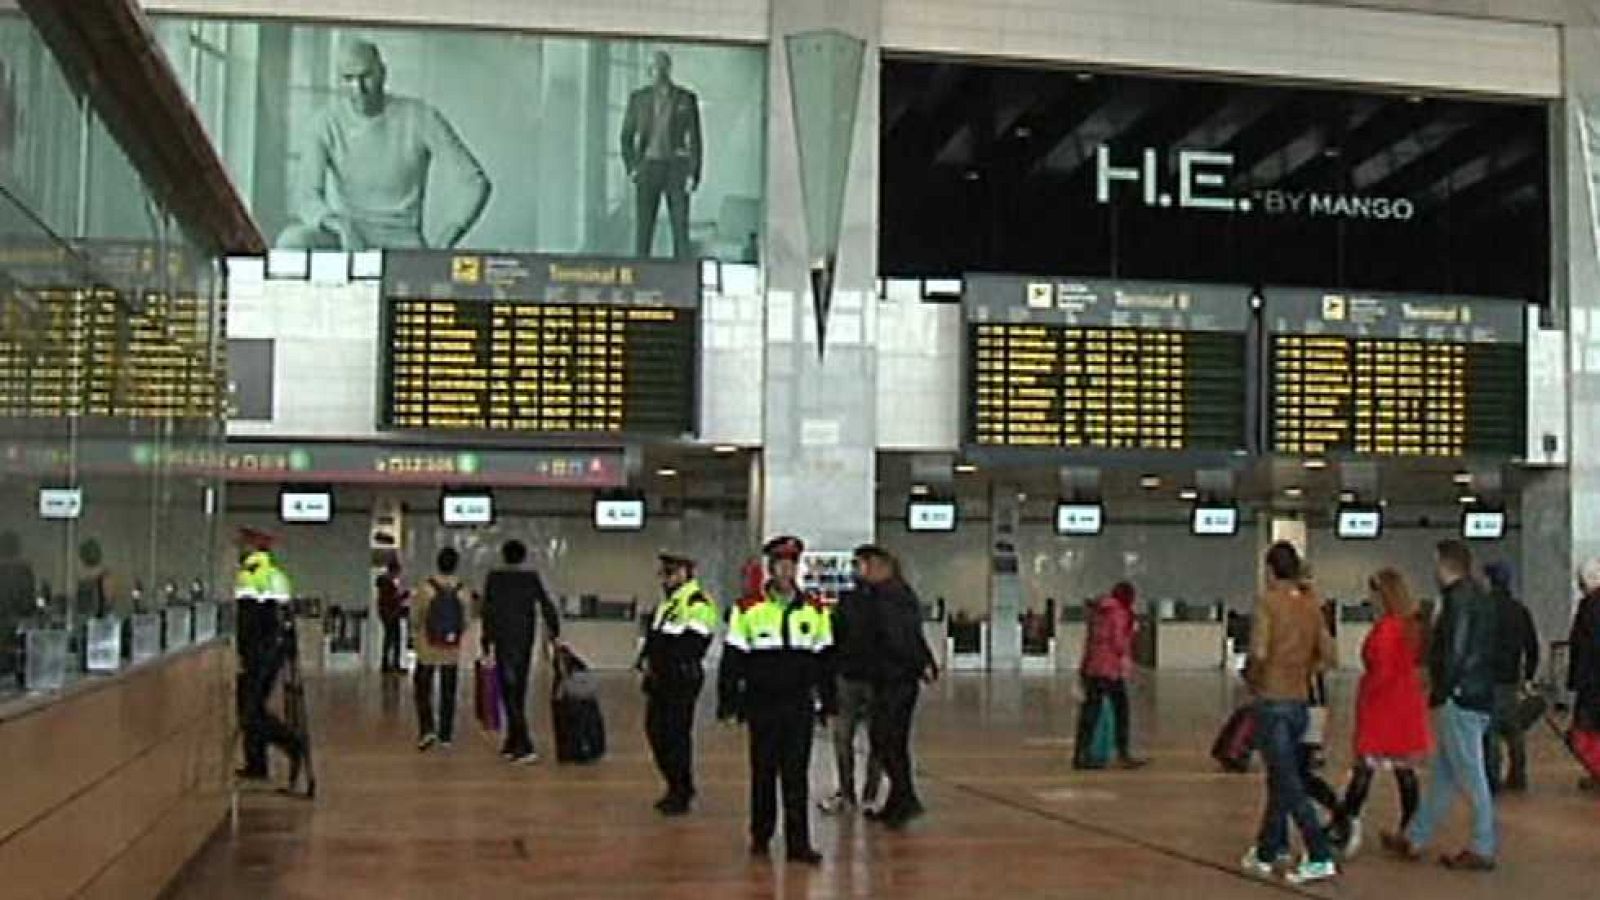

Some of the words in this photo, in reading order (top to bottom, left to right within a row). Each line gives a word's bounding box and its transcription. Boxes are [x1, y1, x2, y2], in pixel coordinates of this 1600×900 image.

[1097, 145, 1252, 211] H.E.
[1266, 190, 1304, 210] BY
[1310, 193, 1414, 219] MANGO
